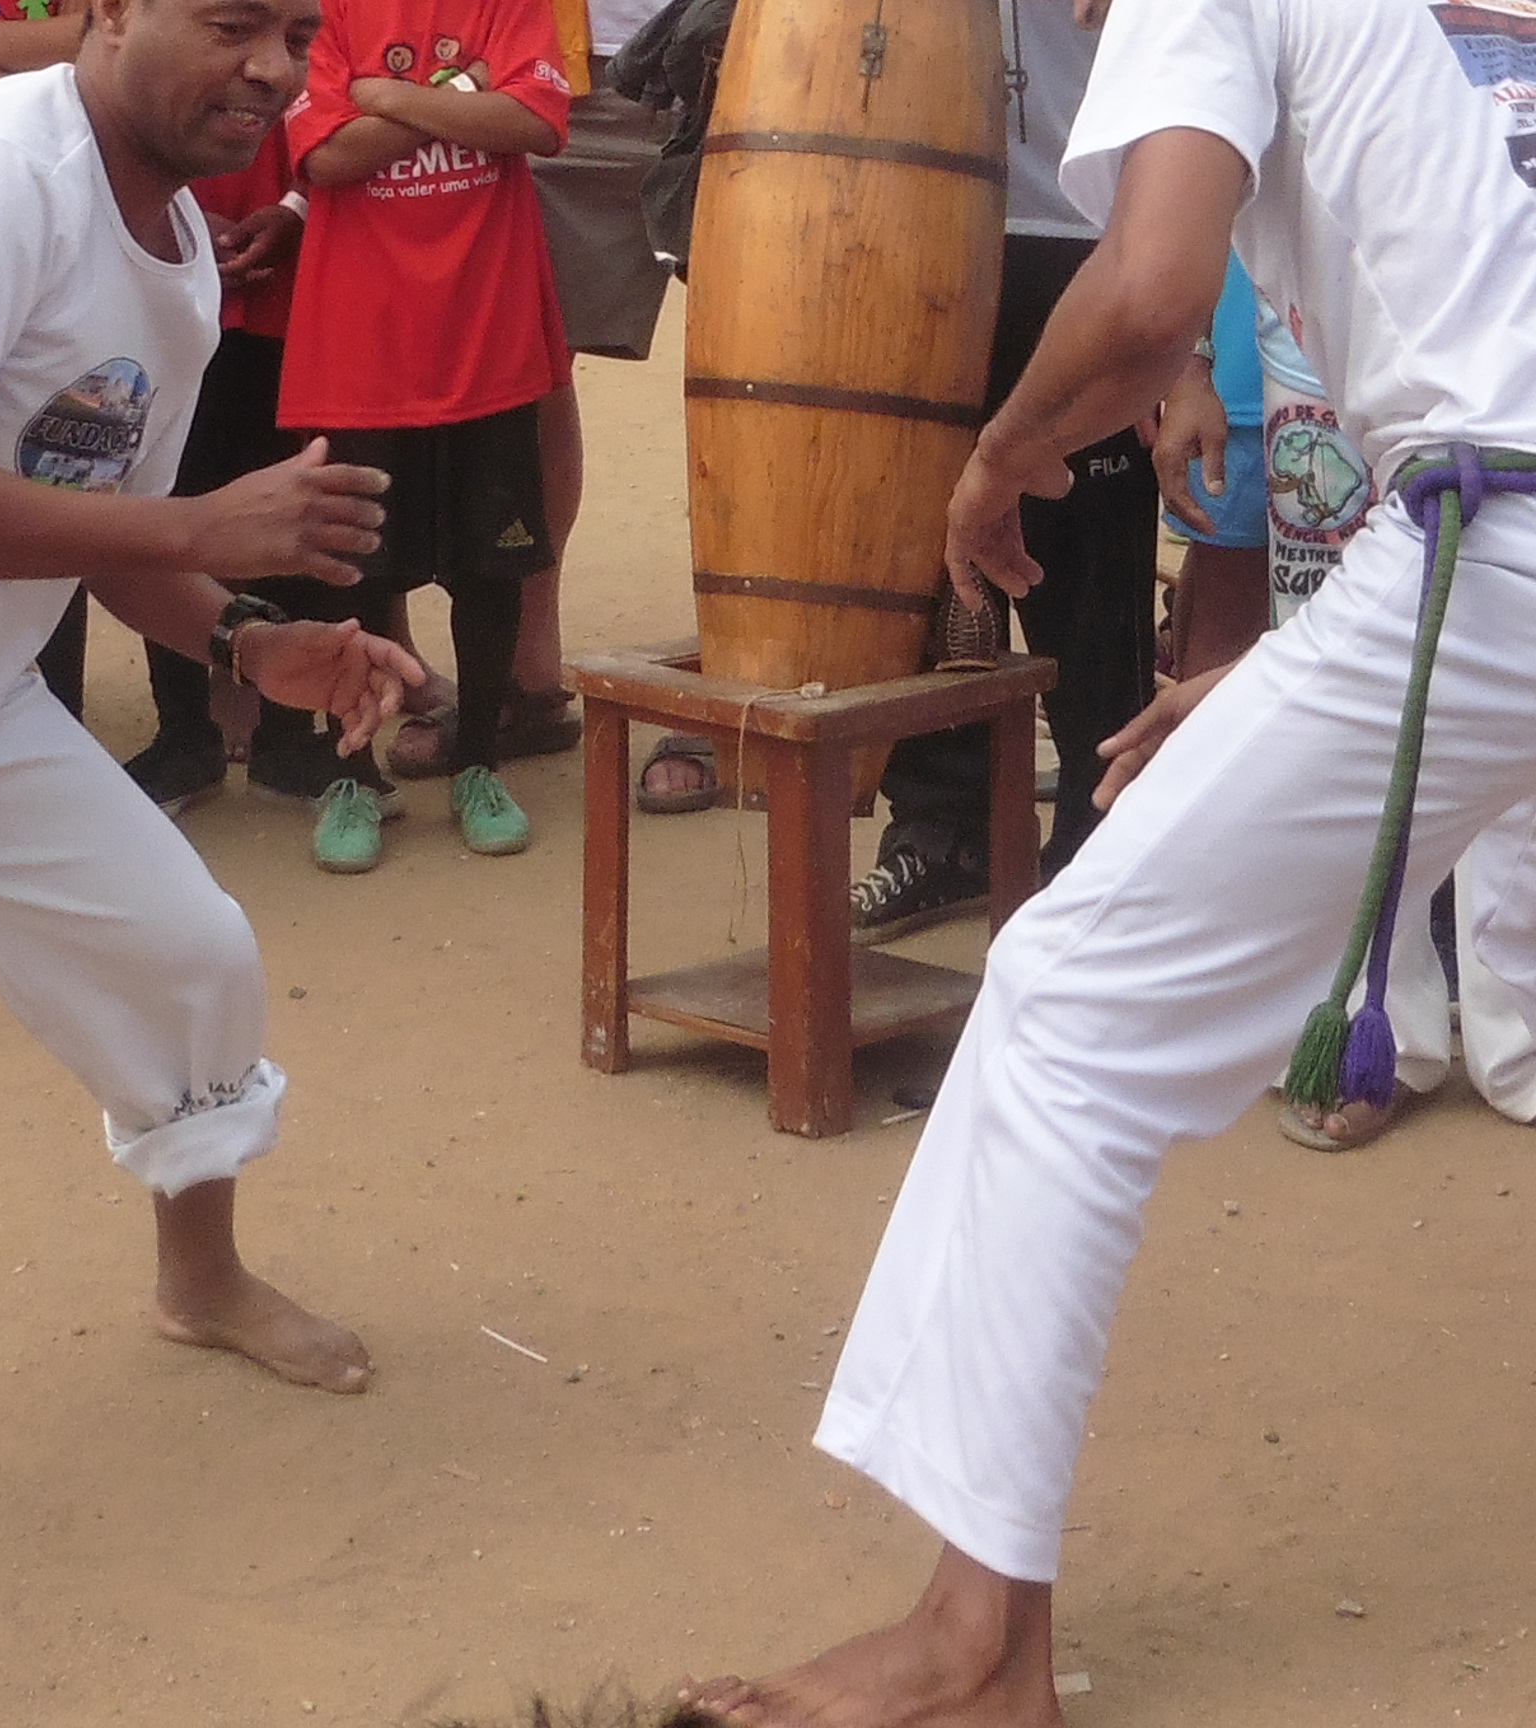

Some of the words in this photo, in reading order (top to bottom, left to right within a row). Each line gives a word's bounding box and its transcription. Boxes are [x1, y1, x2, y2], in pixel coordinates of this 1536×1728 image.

[398, 182, 437, 199] valer
[440, 177, 470, 194] uma
[1088, 454, 1130, 478] FILA
